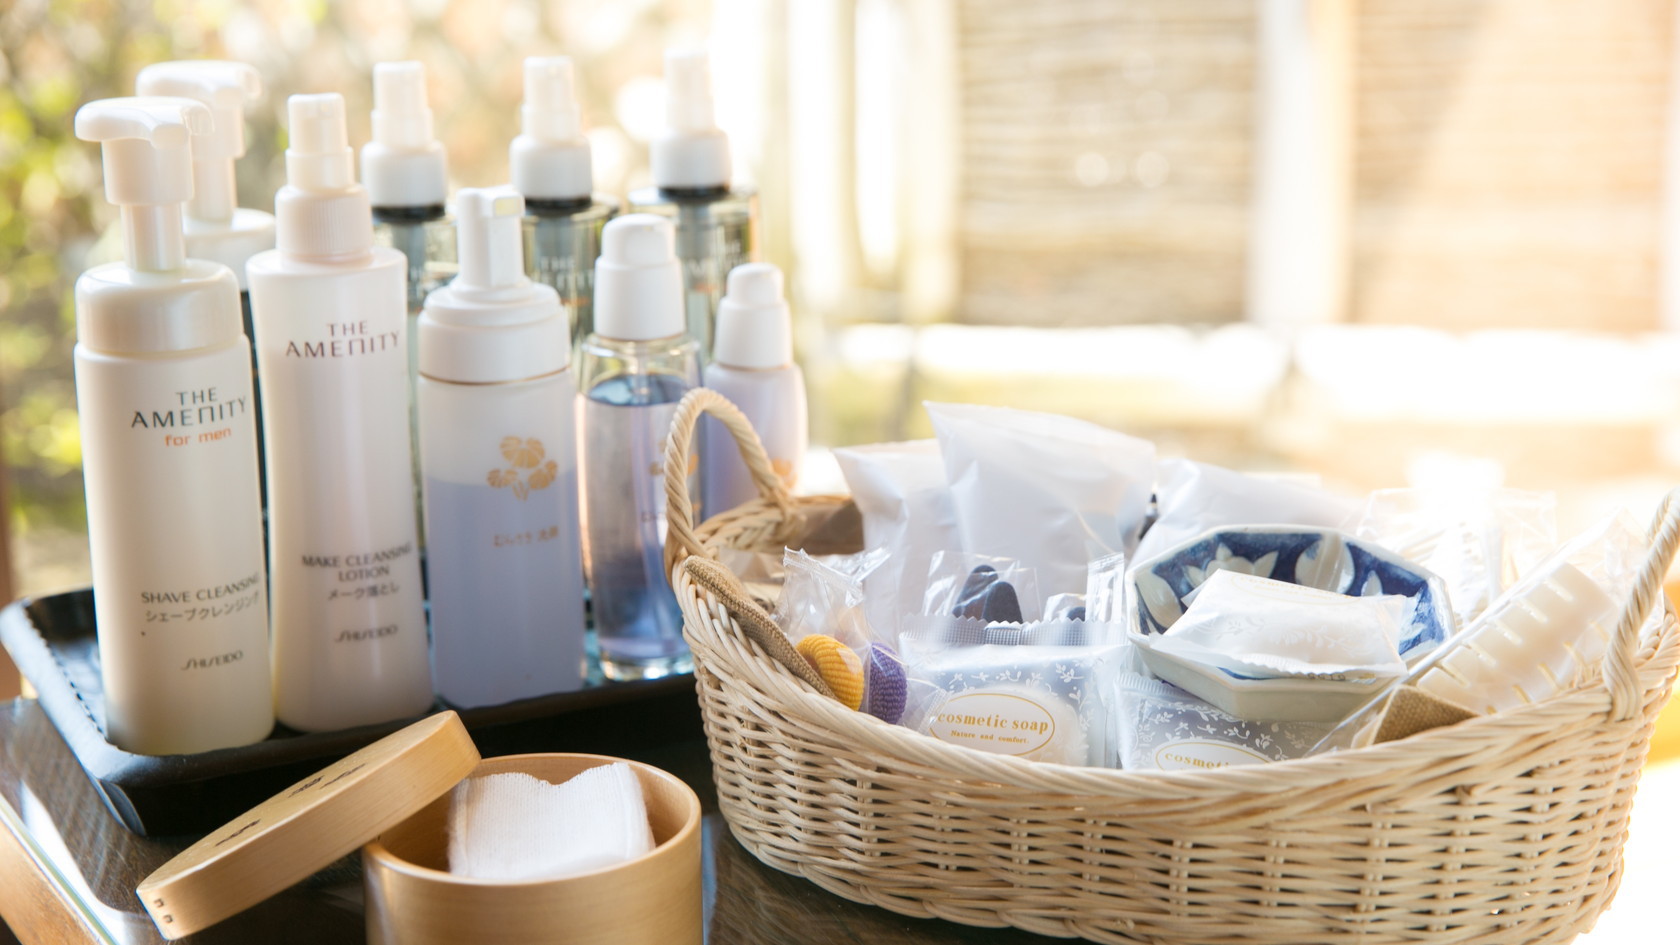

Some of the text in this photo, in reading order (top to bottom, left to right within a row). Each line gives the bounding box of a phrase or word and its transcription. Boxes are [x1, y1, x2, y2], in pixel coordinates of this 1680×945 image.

[326, 320, 367, 336] THE
[286, 330, 399, 357] AMENITY
[175, 387, 218, 406] THE
[131, 396, 246, 428] AMENITY
[164, 428, 232, 446] for men
[302, 555, 340, 567] MAKE
[338, 565, 389, 582] LOTION
[141, 591, 190, 603] SHAVE
[937, 713, 1049, 735] cosmetic soap
[950, 729, 976, 739] Nature
[980, 733, 994, 741] and
